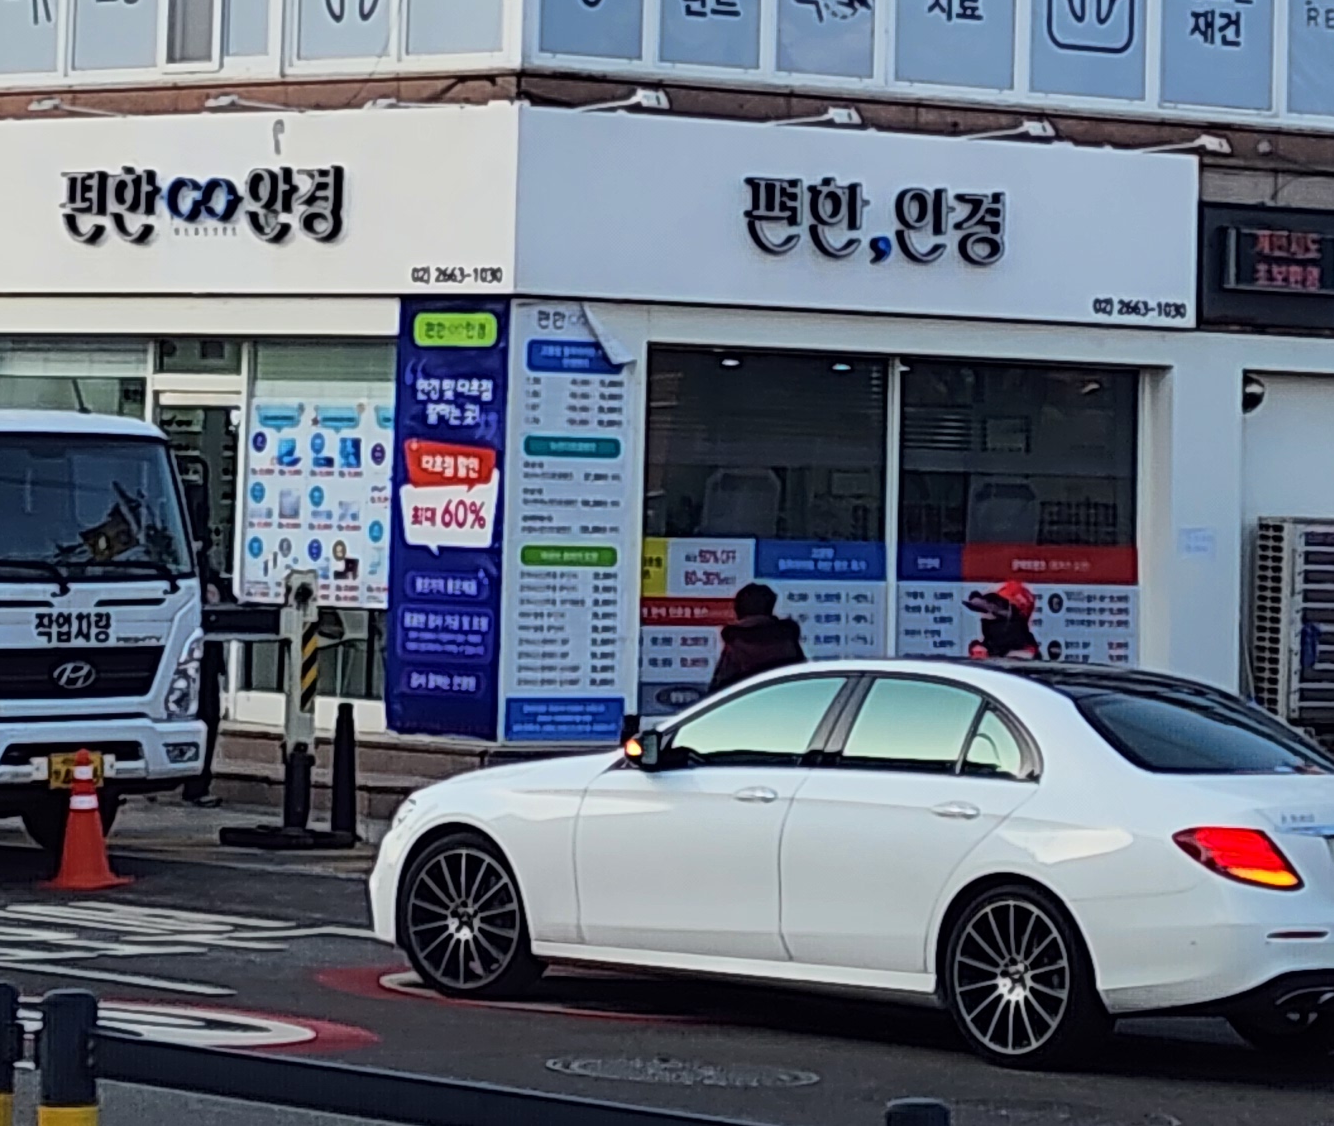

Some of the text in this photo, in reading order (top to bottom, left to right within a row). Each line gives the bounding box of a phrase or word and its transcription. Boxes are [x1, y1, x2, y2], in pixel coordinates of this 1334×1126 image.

[1189, 7, 1243, 50] 재건
[61, 165, 346, 245] 편한 안경
[440, 498, 487, 530] 60%
[34, 612, 113, 644] 작업차량
